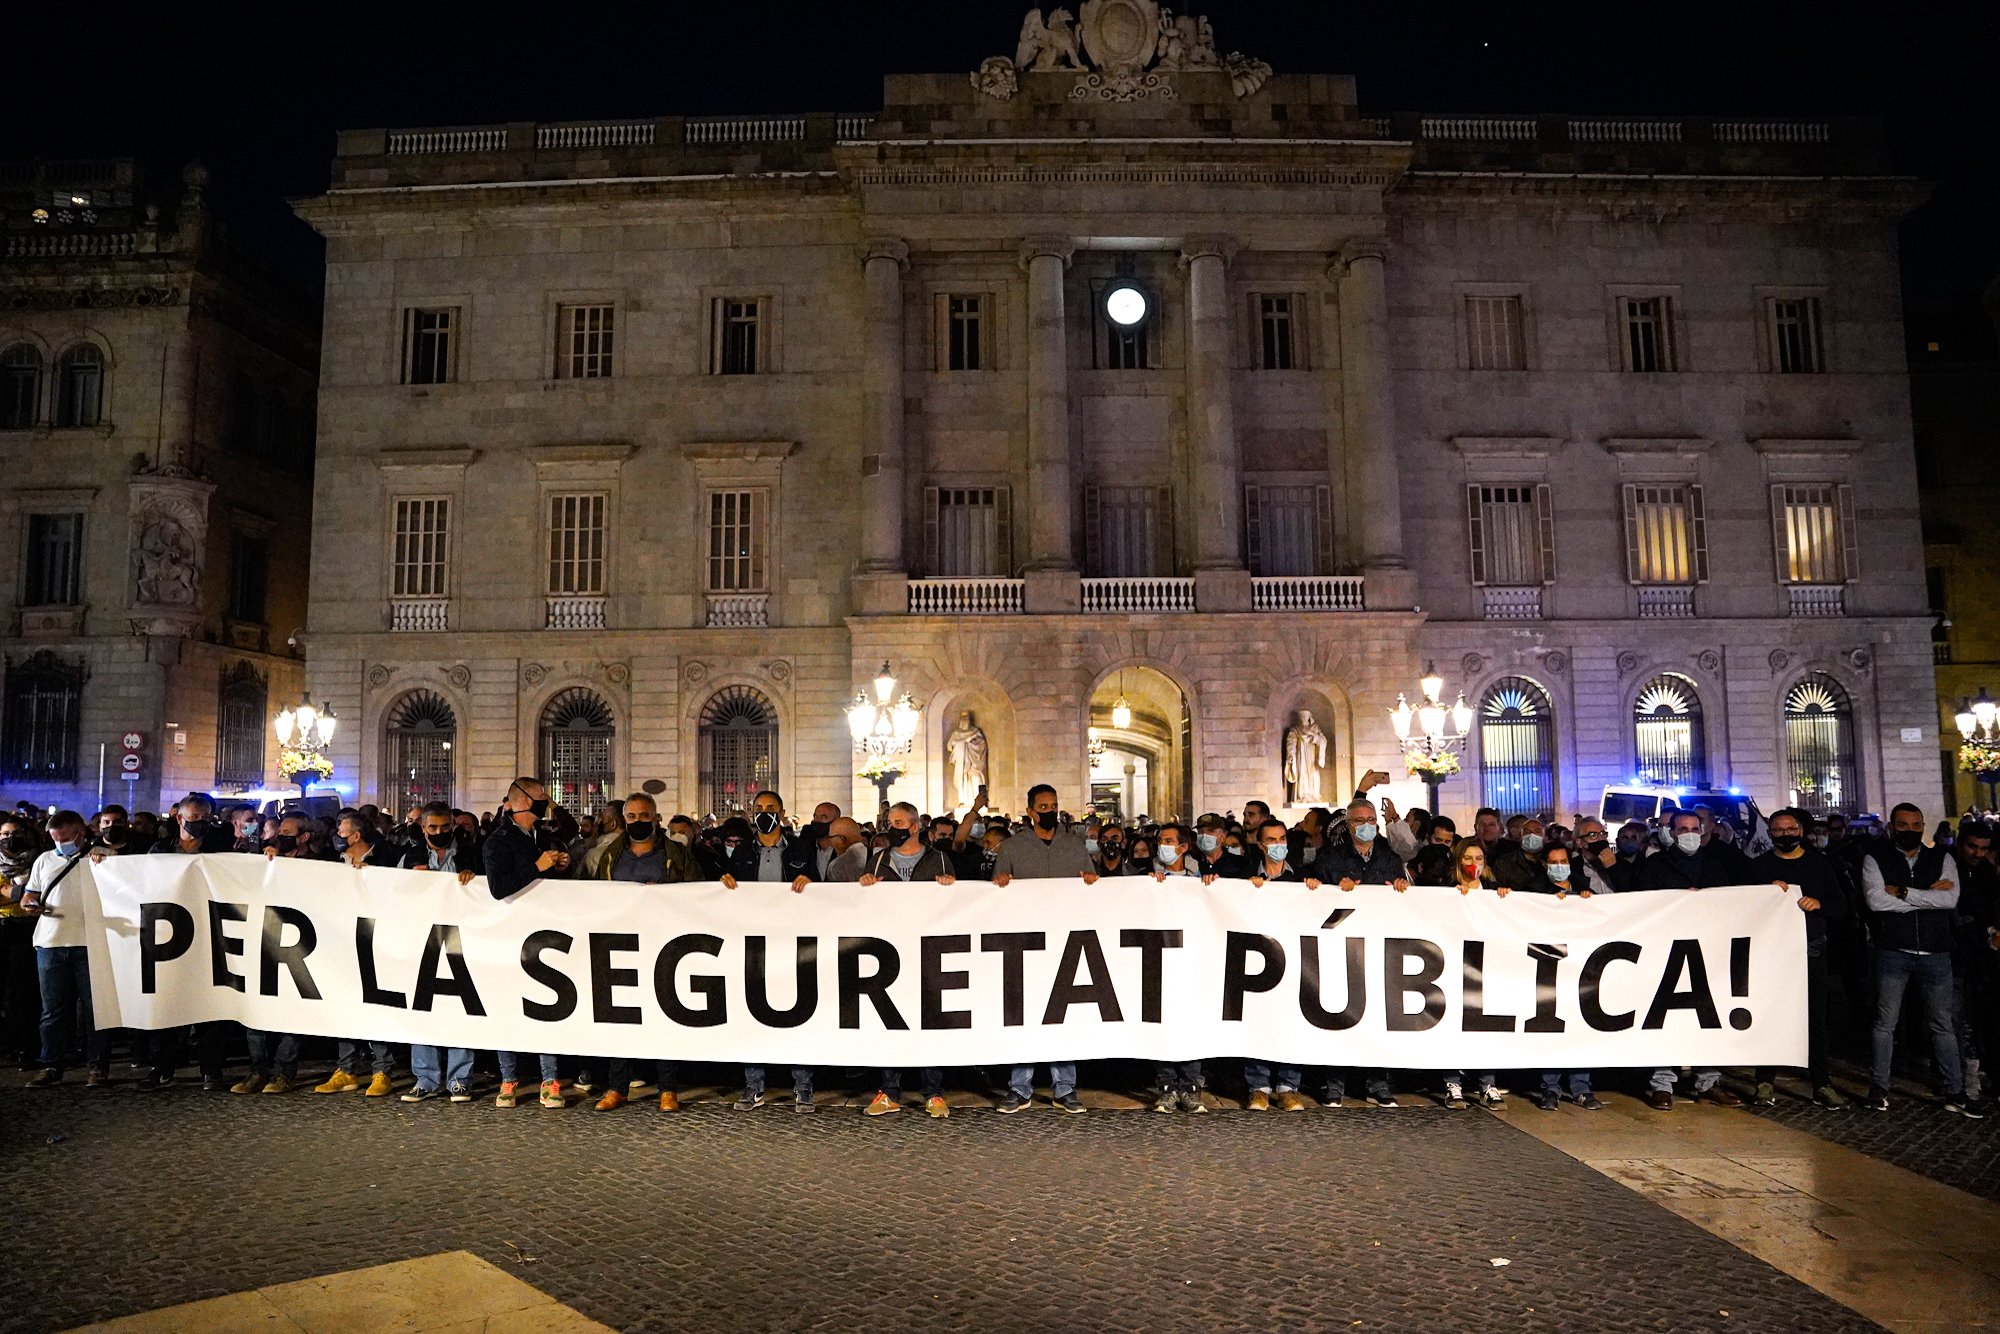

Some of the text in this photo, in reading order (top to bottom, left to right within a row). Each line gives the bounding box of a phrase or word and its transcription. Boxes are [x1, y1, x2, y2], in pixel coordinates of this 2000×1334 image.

[139, 899, 1753, 1034] PER LA SEGURETAT PÚBLICA!
